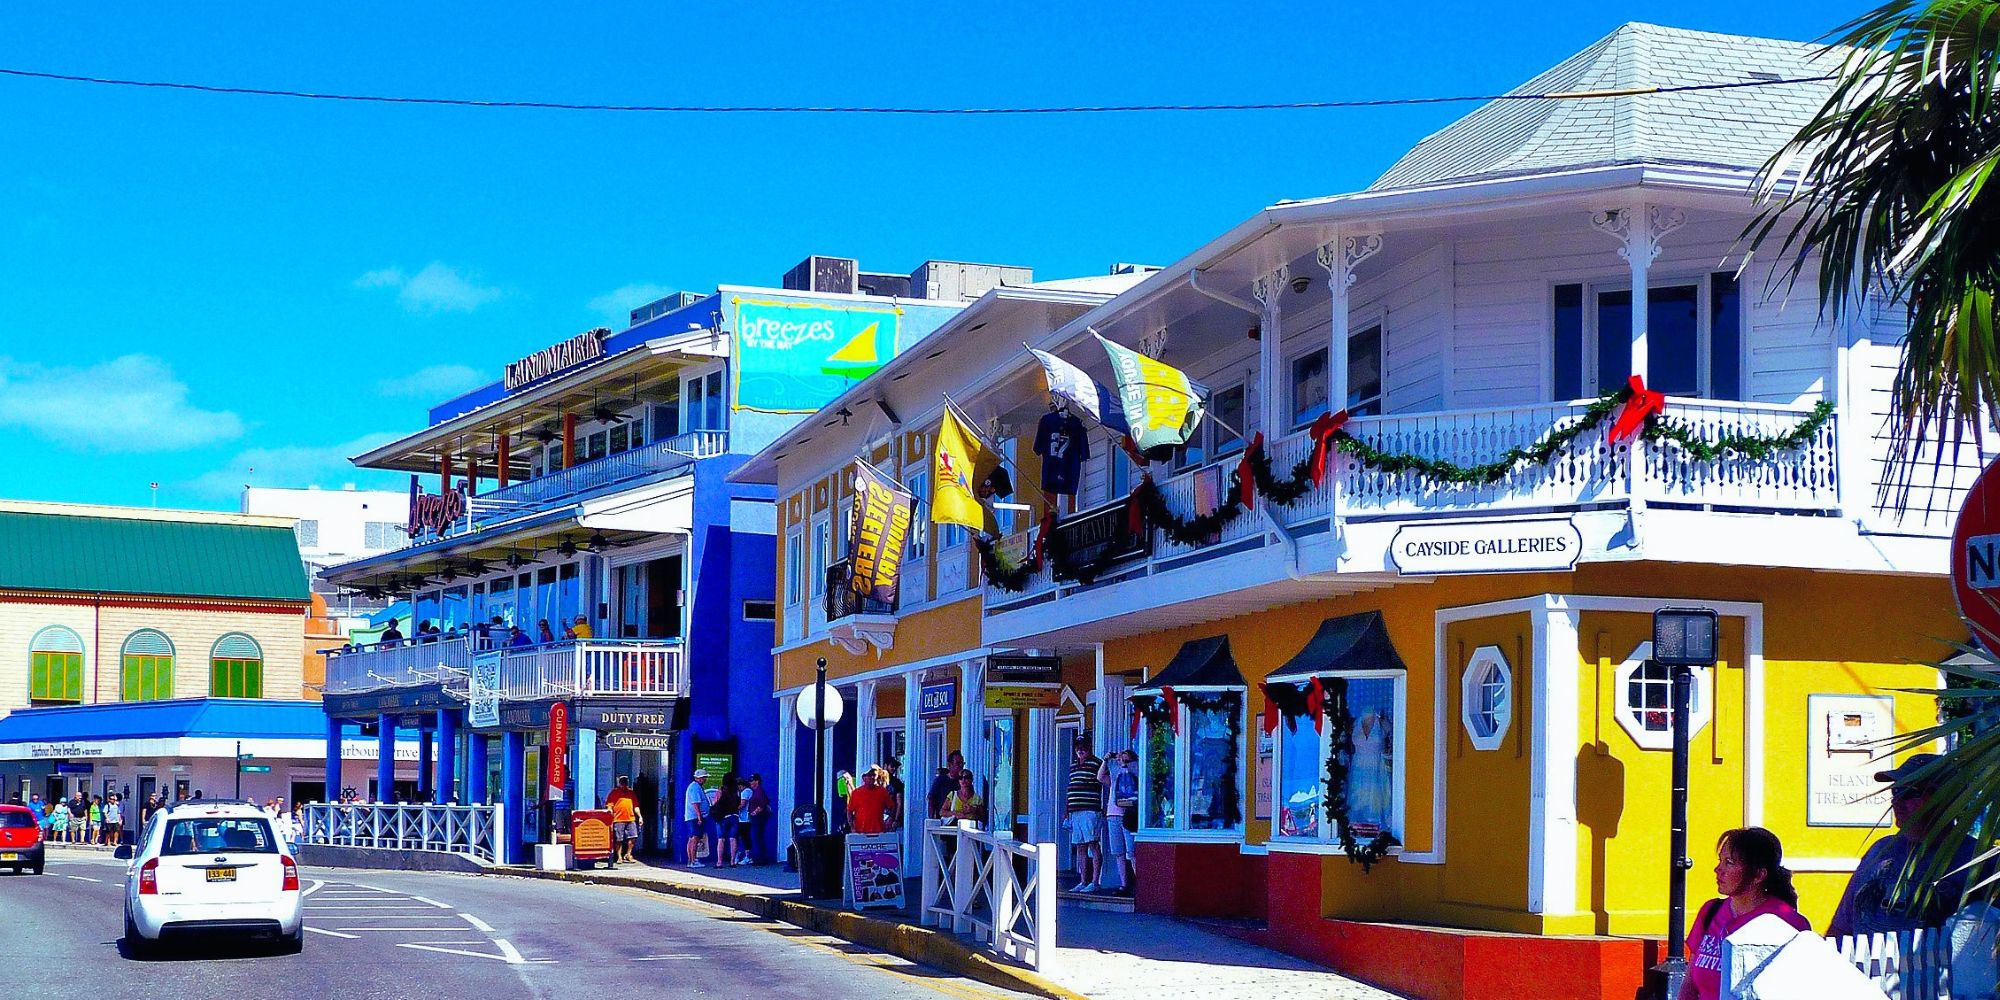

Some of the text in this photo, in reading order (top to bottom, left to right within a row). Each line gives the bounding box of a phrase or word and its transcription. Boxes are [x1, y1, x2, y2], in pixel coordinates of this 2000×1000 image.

[741, 314, 835, 345] breezes
[503, 327, 602, 392] LANDMARK
[1405, 537, 1567, 557] CAYSIDE GALLERIES
[924, 691, 949, 709] DEL SOL
[601, 712, 665, 725] DUTY FREE
[553, 708, 564, 783] CUBAN CIGARS
[613, 736, 668, 748] LANDMARK
[395, 748, 418, 758] rive
[1829, 774, 1874, 787] ISLAND
[1815, 792, 1888, 805] TREASURES
